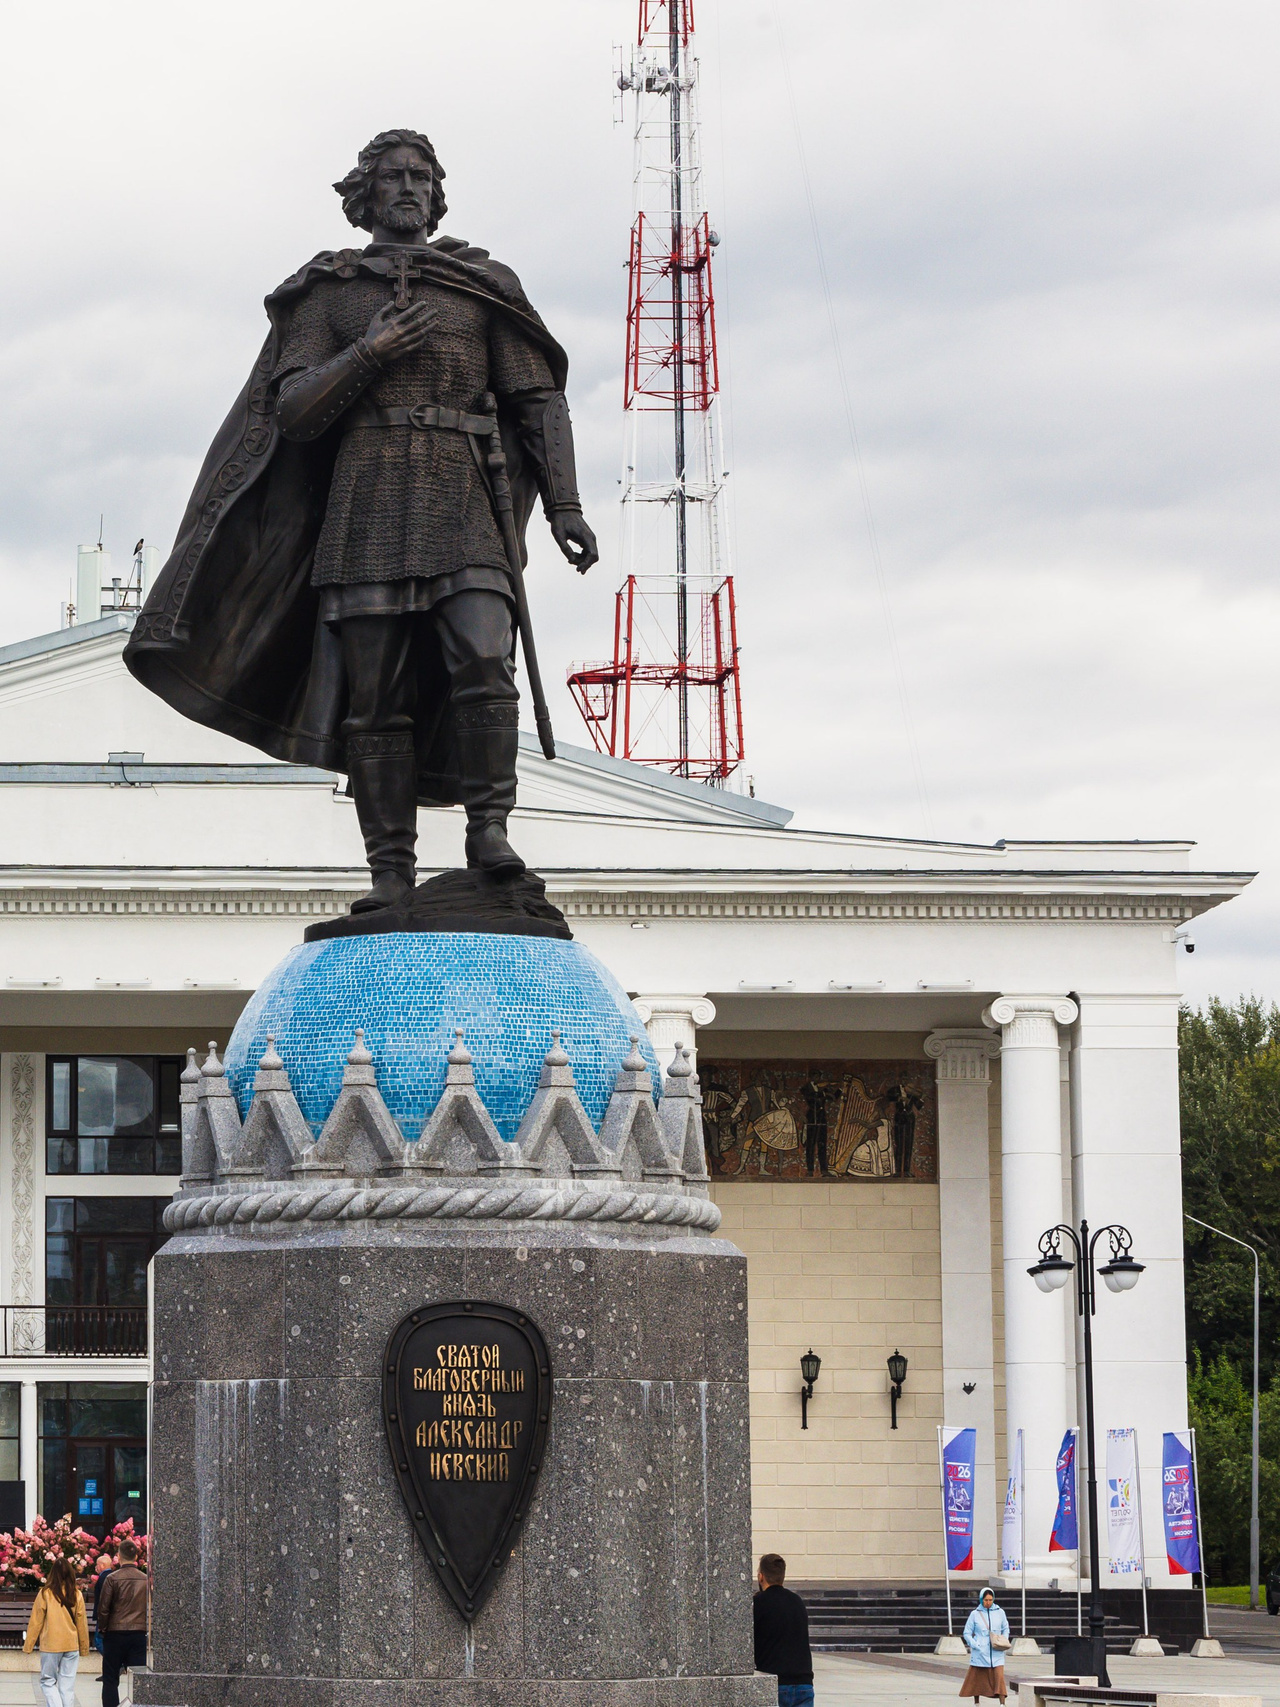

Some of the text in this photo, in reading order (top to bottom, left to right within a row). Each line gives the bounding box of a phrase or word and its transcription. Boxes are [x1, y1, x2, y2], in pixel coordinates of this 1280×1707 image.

[413, 1368, 524, 1393] БЛАГОВЕРНЫЙ
[416, 1420, 523, 1449] АЛЕКСАНДР
[430, 1452, 509, 1482] НЕВСКИЙ
[947, 1465, 971, 1478] 2026
